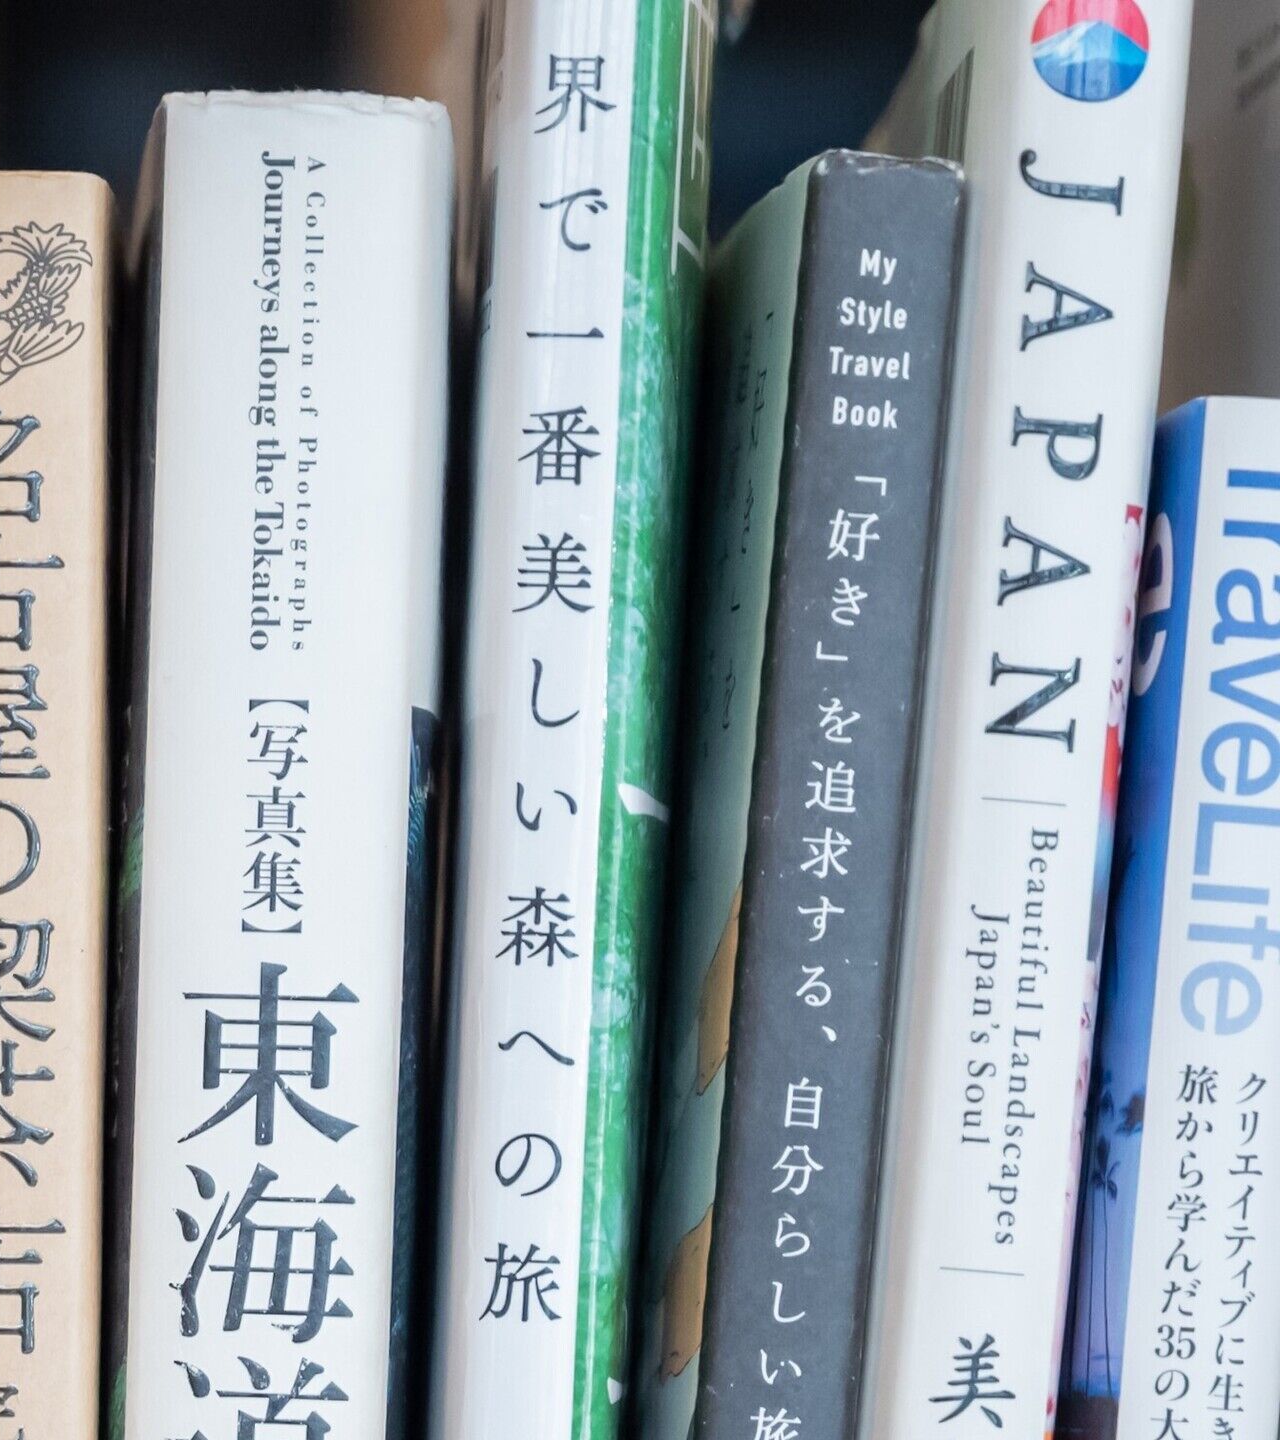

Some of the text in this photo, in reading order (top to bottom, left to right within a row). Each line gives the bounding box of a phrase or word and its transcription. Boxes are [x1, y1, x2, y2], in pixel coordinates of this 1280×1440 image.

[858, 248, 898, 284] My
[839, 297, 909, 334] Style
[248, 150, 297, 652] Journeys along the Tokaido
[288, 156, 326, 650] A Collection of Photographs
[829, 346, 912, 382] Travel
[831, 396, 900, 431] Book
[984, 149, 1126, 754] JAPAN
[988, 826, 1060, 1247] Beautiful Landscapes
[960, 1057, 1000, 1145] Soul
